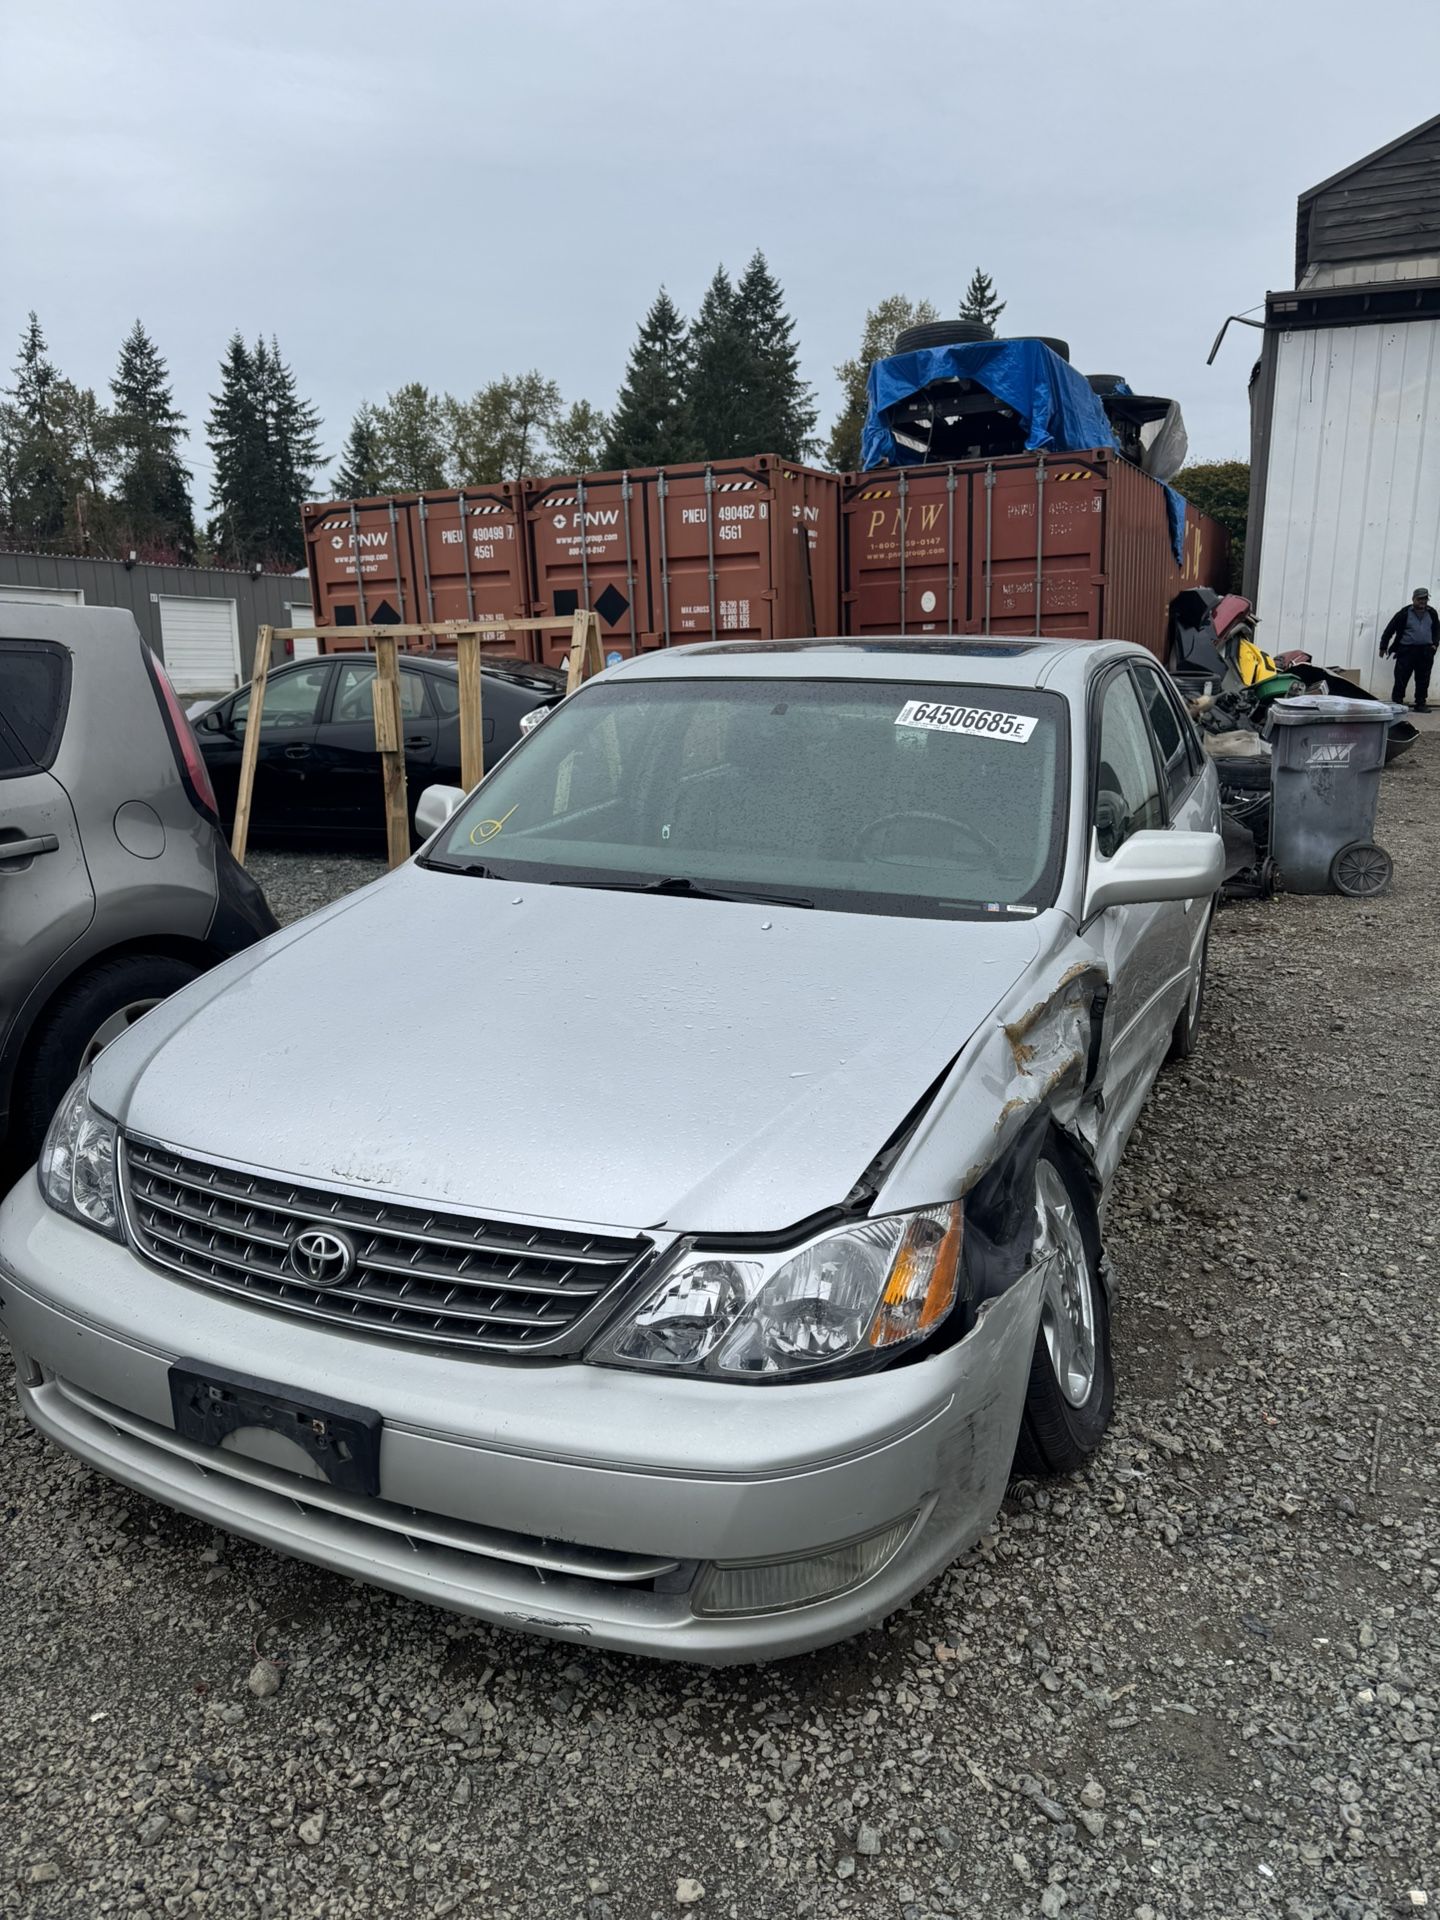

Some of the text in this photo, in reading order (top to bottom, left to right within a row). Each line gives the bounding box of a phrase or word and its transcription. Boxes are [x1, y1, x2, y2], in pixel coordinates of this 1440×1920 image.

[573, 510, 619, 528] PNW
[682, 508, 707, 524] PNEU
[718, 505, 755, 521] 490462
[867, 503, 944, 538] PNW
[348, 532, 388, 548] PNW
[442, 530, 463, 544] PNEU
[472, 526, 504, 541] 490499
[556, 533, 618, 545] www.pngroup.com
[871, 537, 941, 550] 1-800-59-0147
